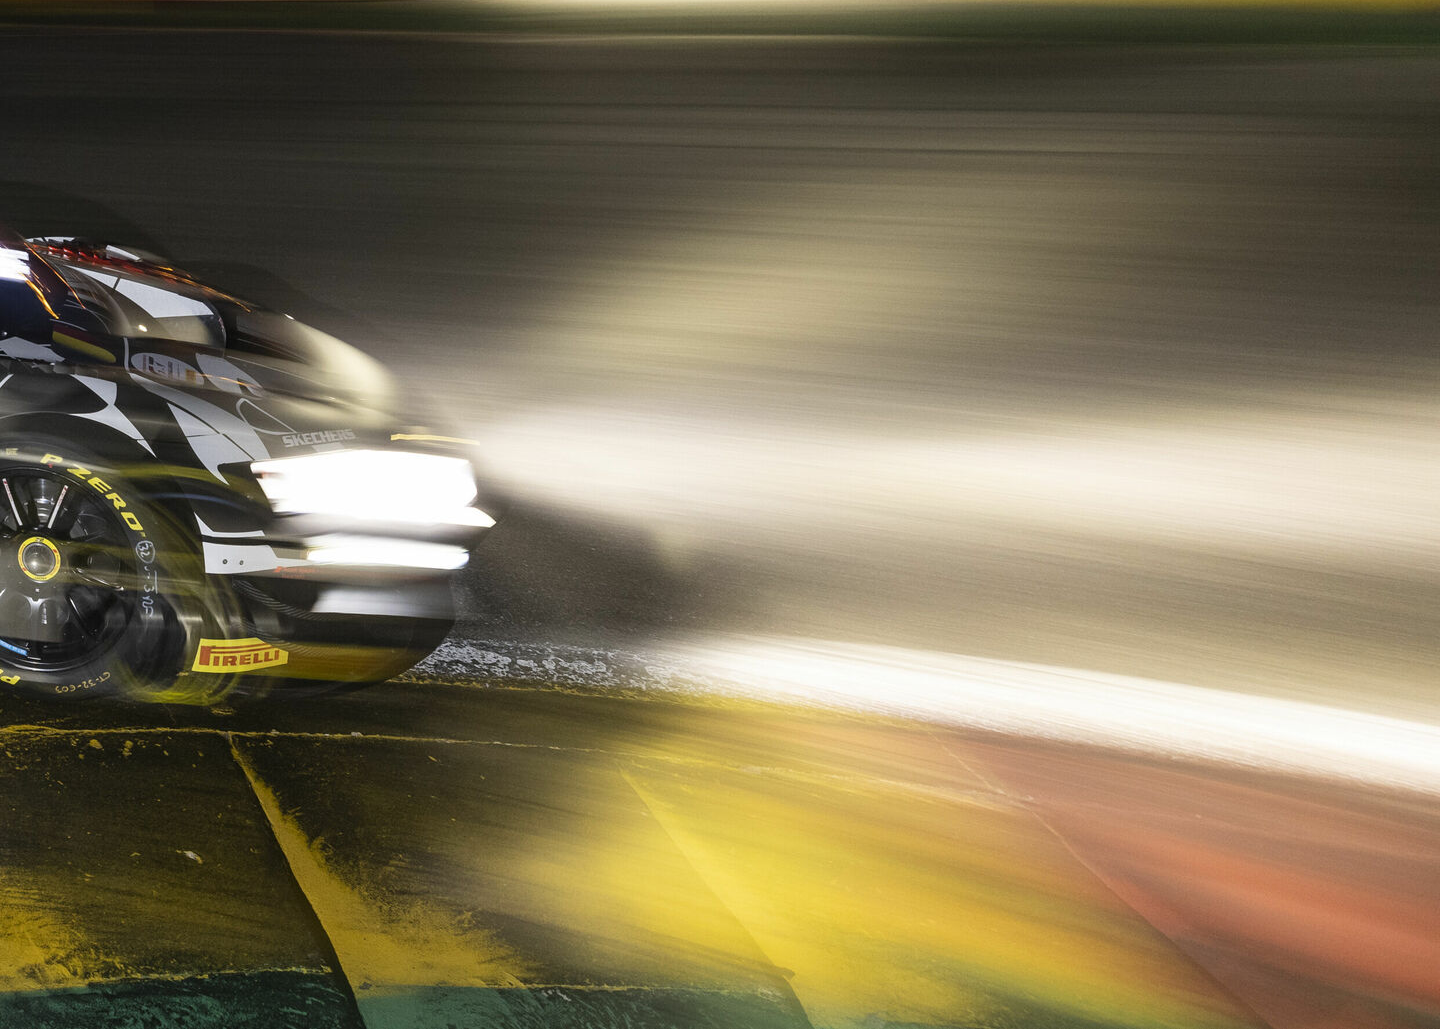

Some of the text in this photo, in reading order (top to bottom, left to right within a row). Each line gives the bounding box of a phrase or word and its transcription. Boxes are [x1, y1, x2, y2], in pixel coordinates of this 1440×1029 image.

[282, 428, 356, 448] SKECHERS
[40, 453, 143, 531] P ZERO
[199, 643, 280, 666] PIRELLI
